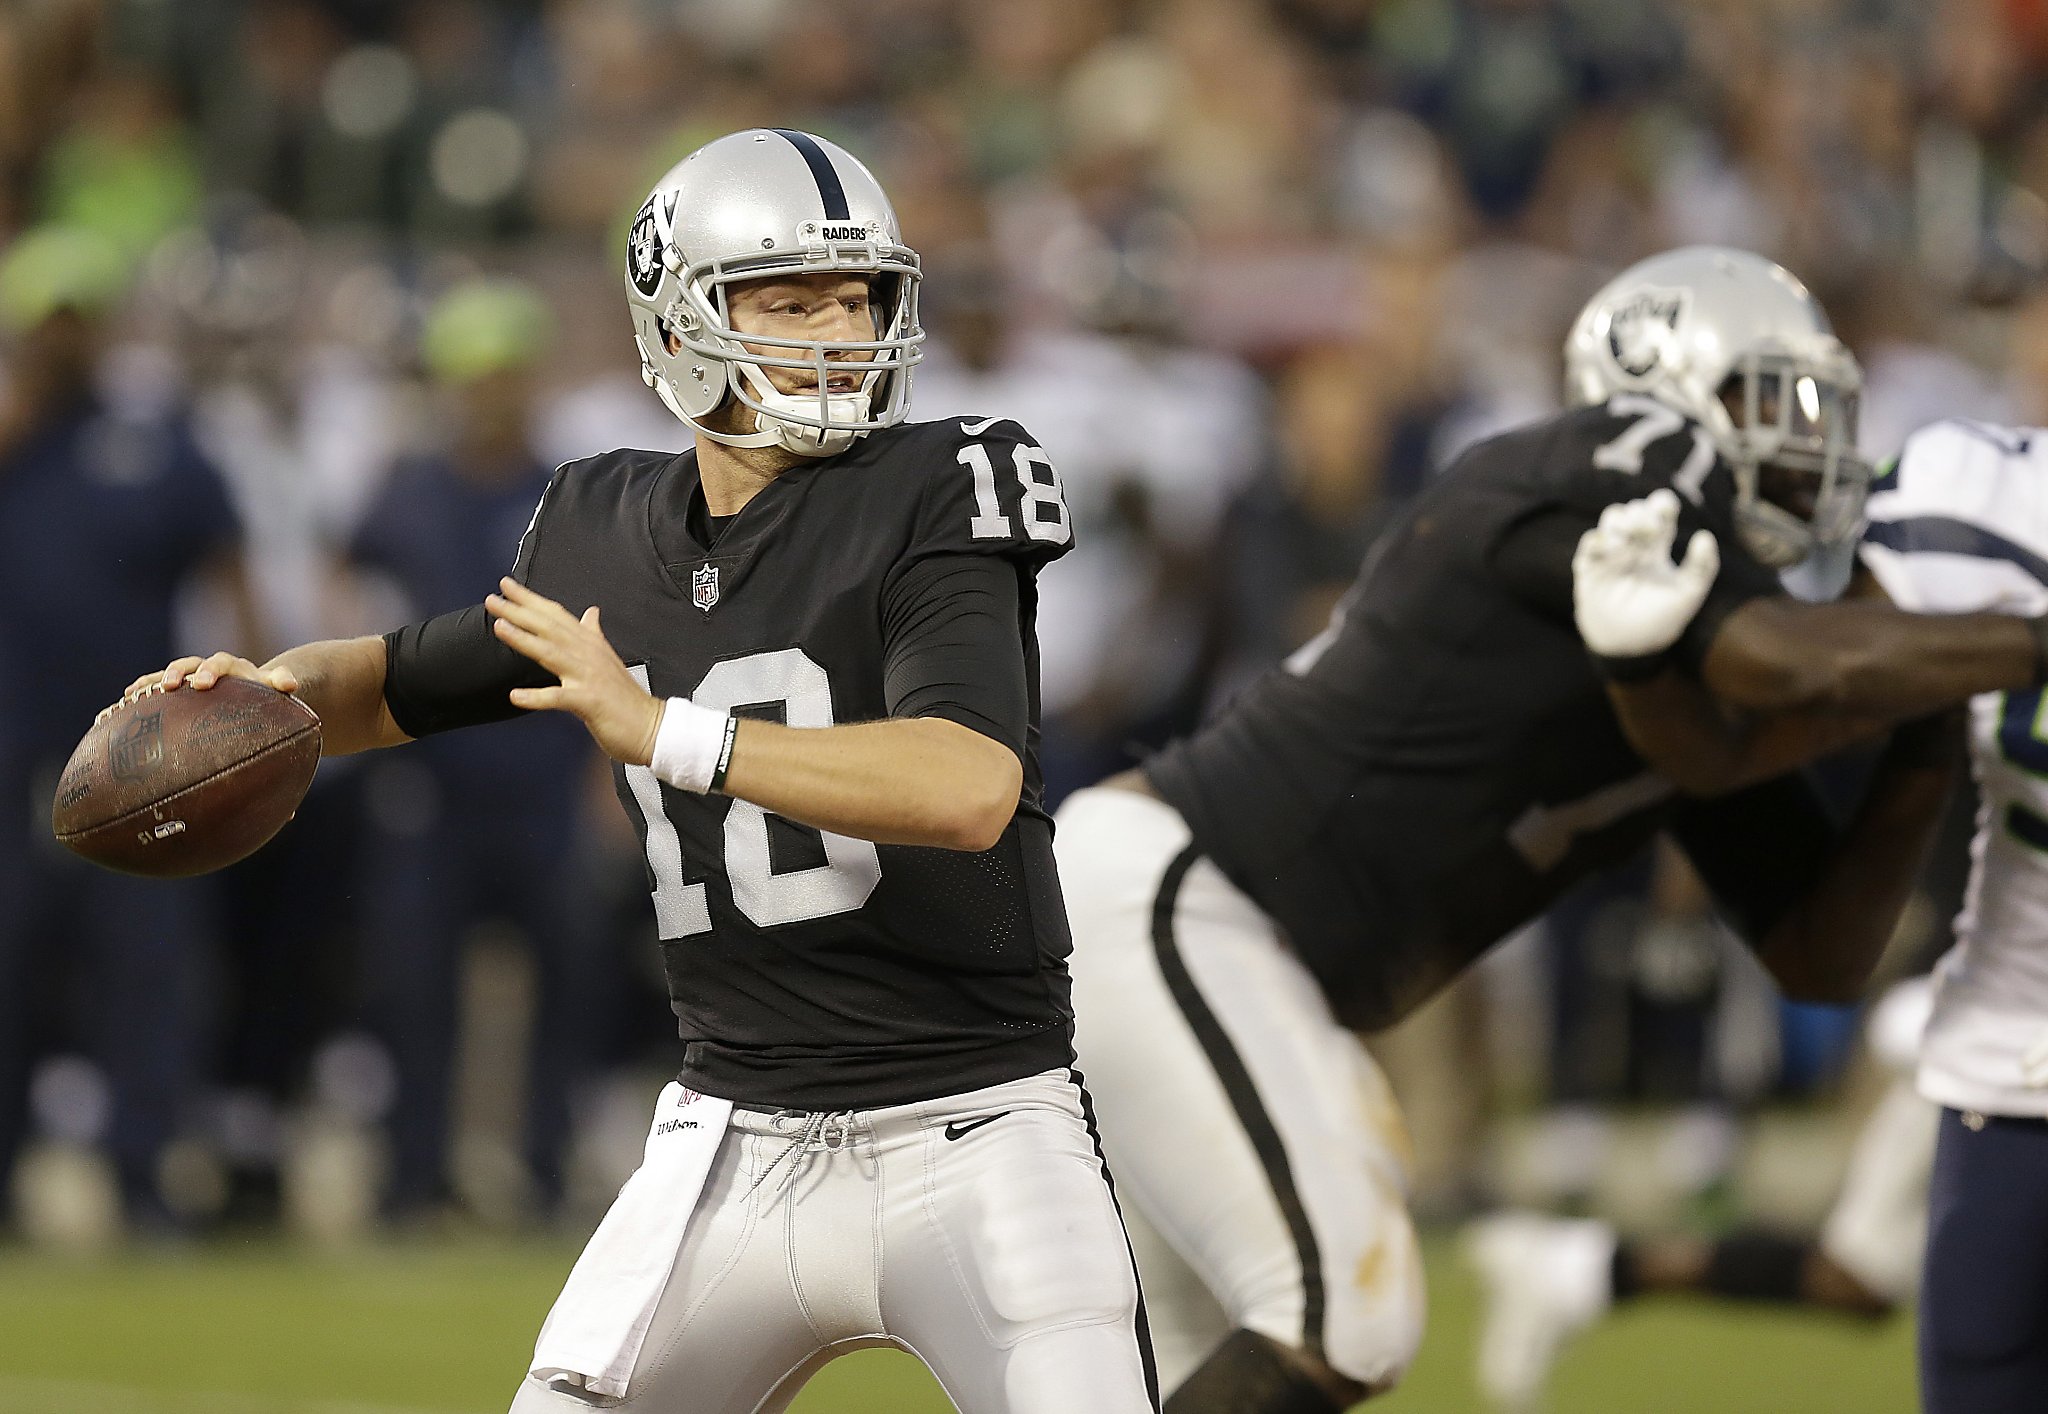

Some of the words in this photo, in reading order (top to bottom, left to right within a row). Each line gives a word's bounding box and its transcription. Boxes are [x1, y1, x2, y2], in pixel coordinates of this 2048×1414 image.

[822, 226, 866, 241] RAIDERS
[1593, 395, 1718, 507] 71
[956, 443, 1071, 546] 18
[696, 584, 716, 603] NFL
[61, 783, 90, 810] Wilson
[624, 648, 882, 941] 18
[657, 1118, 698, 1136] Wilson
